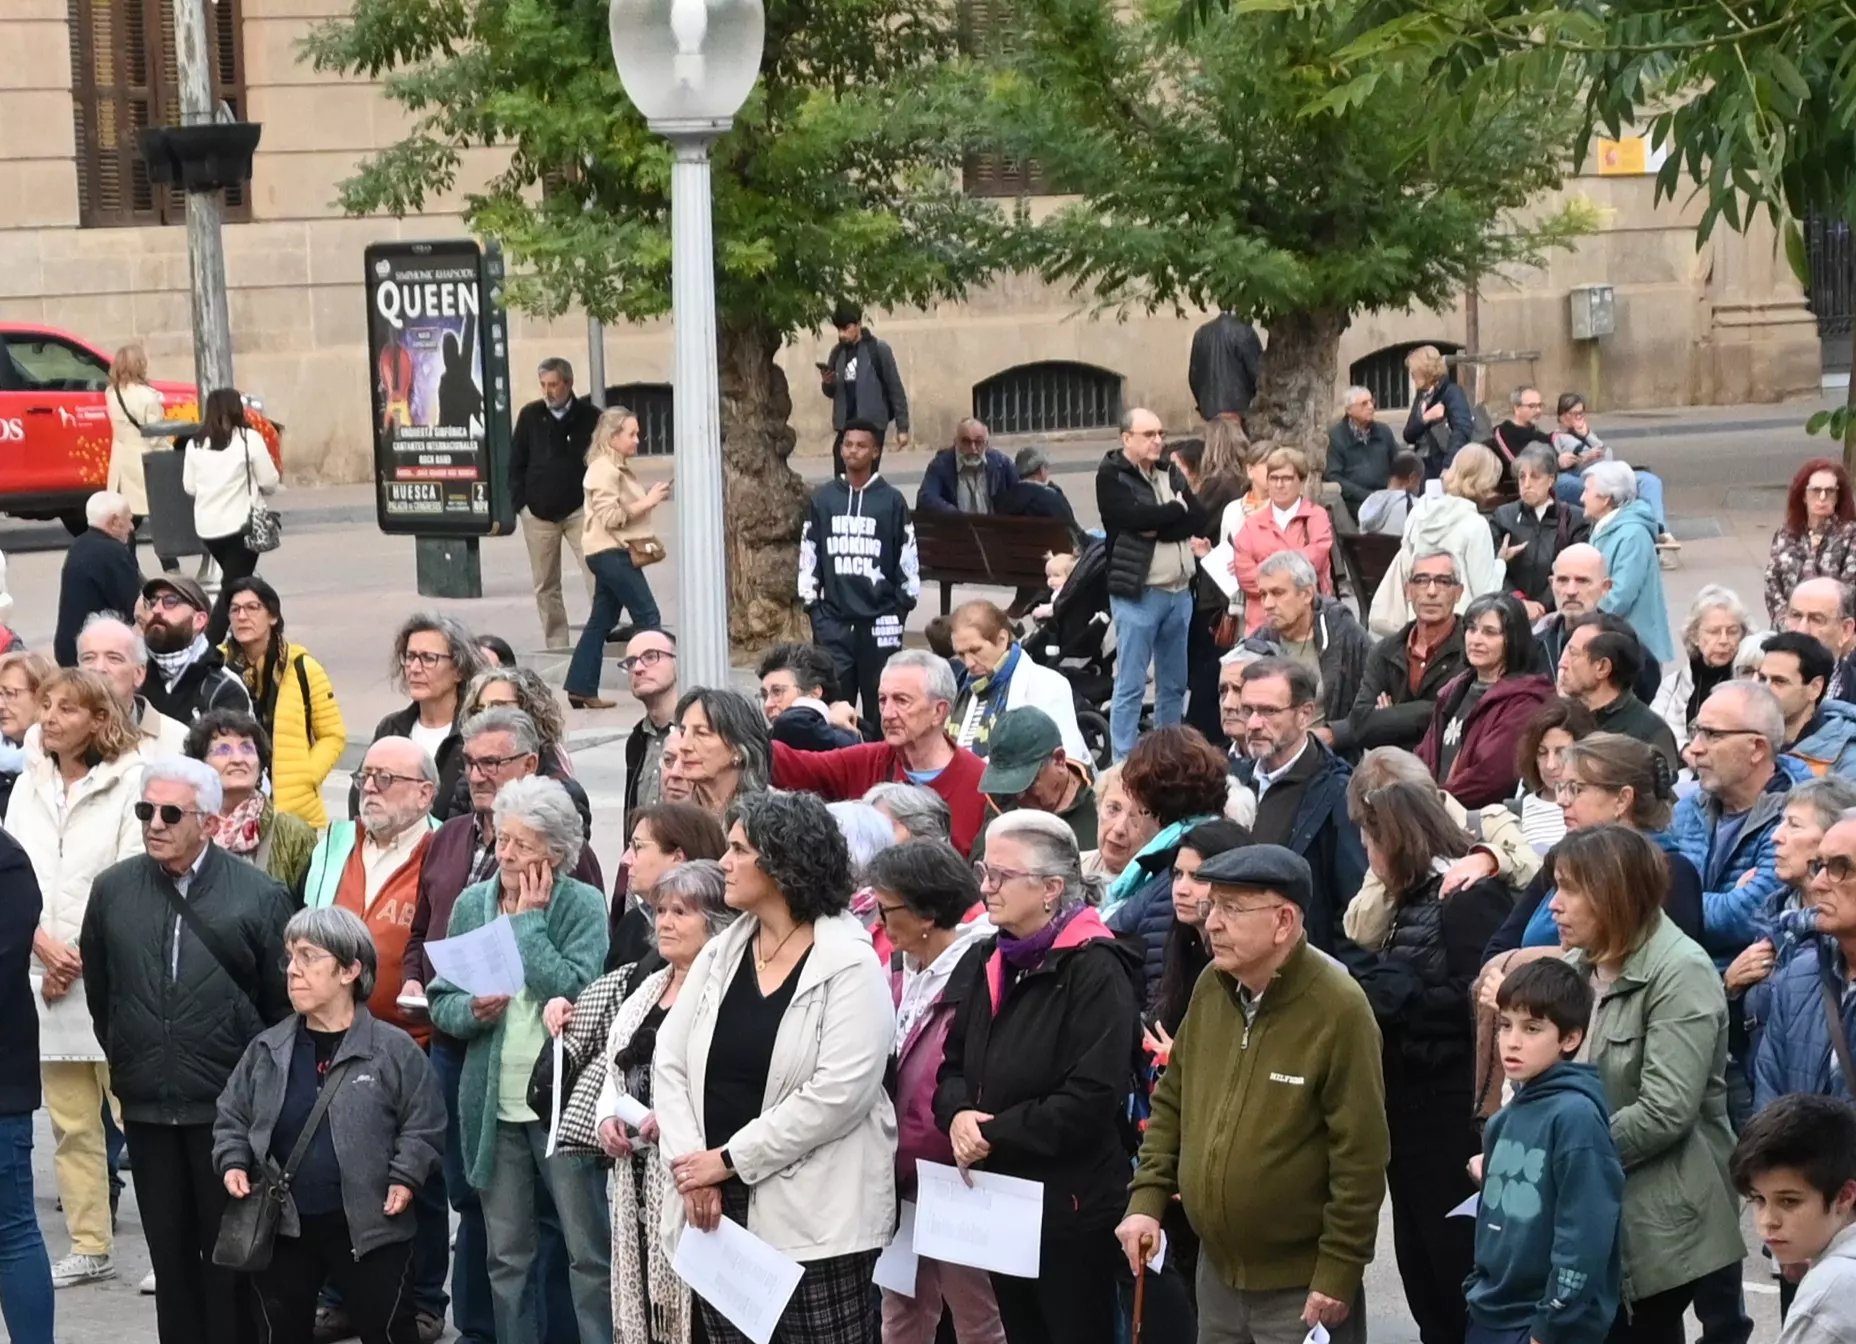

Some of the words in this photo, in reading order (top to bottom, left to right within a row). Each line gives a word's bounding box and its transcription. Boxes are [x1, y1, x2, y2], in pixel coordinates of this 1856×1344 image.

[376, 280, 479, 329] QUEEN
[392, 484, 437, 500] HUESCA
[477, 484, 485, 500] 2
[473, 500, 489, 513] NOV
[831, 514, 877, 535] NEVER
[826, 535, 882, 557] LOOKING
[834, 556, 874, 576] BACK
